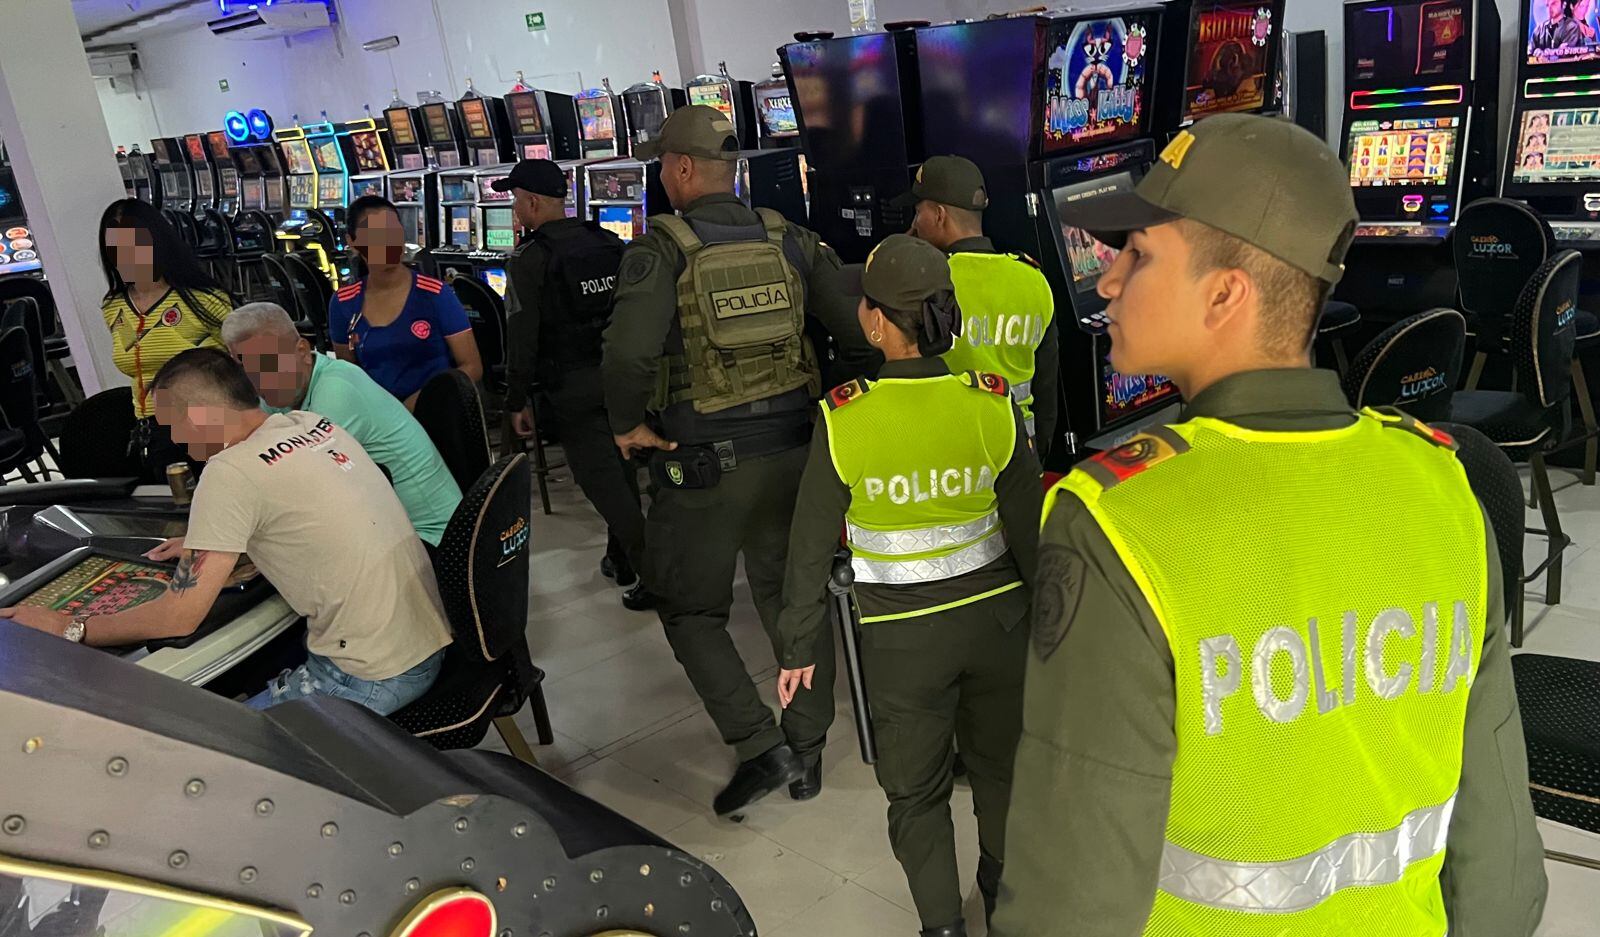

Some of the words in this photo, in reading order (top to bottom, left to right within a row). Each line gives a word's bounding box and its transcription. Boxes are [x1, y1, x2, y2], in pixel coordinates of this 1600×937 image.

[767, 96, 793, 111] XERXE
[1050, 95, 1090, 135] Miss
[1097, 84, 1136, 123] Kitty
[580, 275, 616, 295] POLIC
[715, 287, 788, 313] POLICÍA
[950, 313, 1043, 348] OLICIA
[864, 465, 995, 505] POLICIA
[1199, 600, 1474, 737] POLICIA
